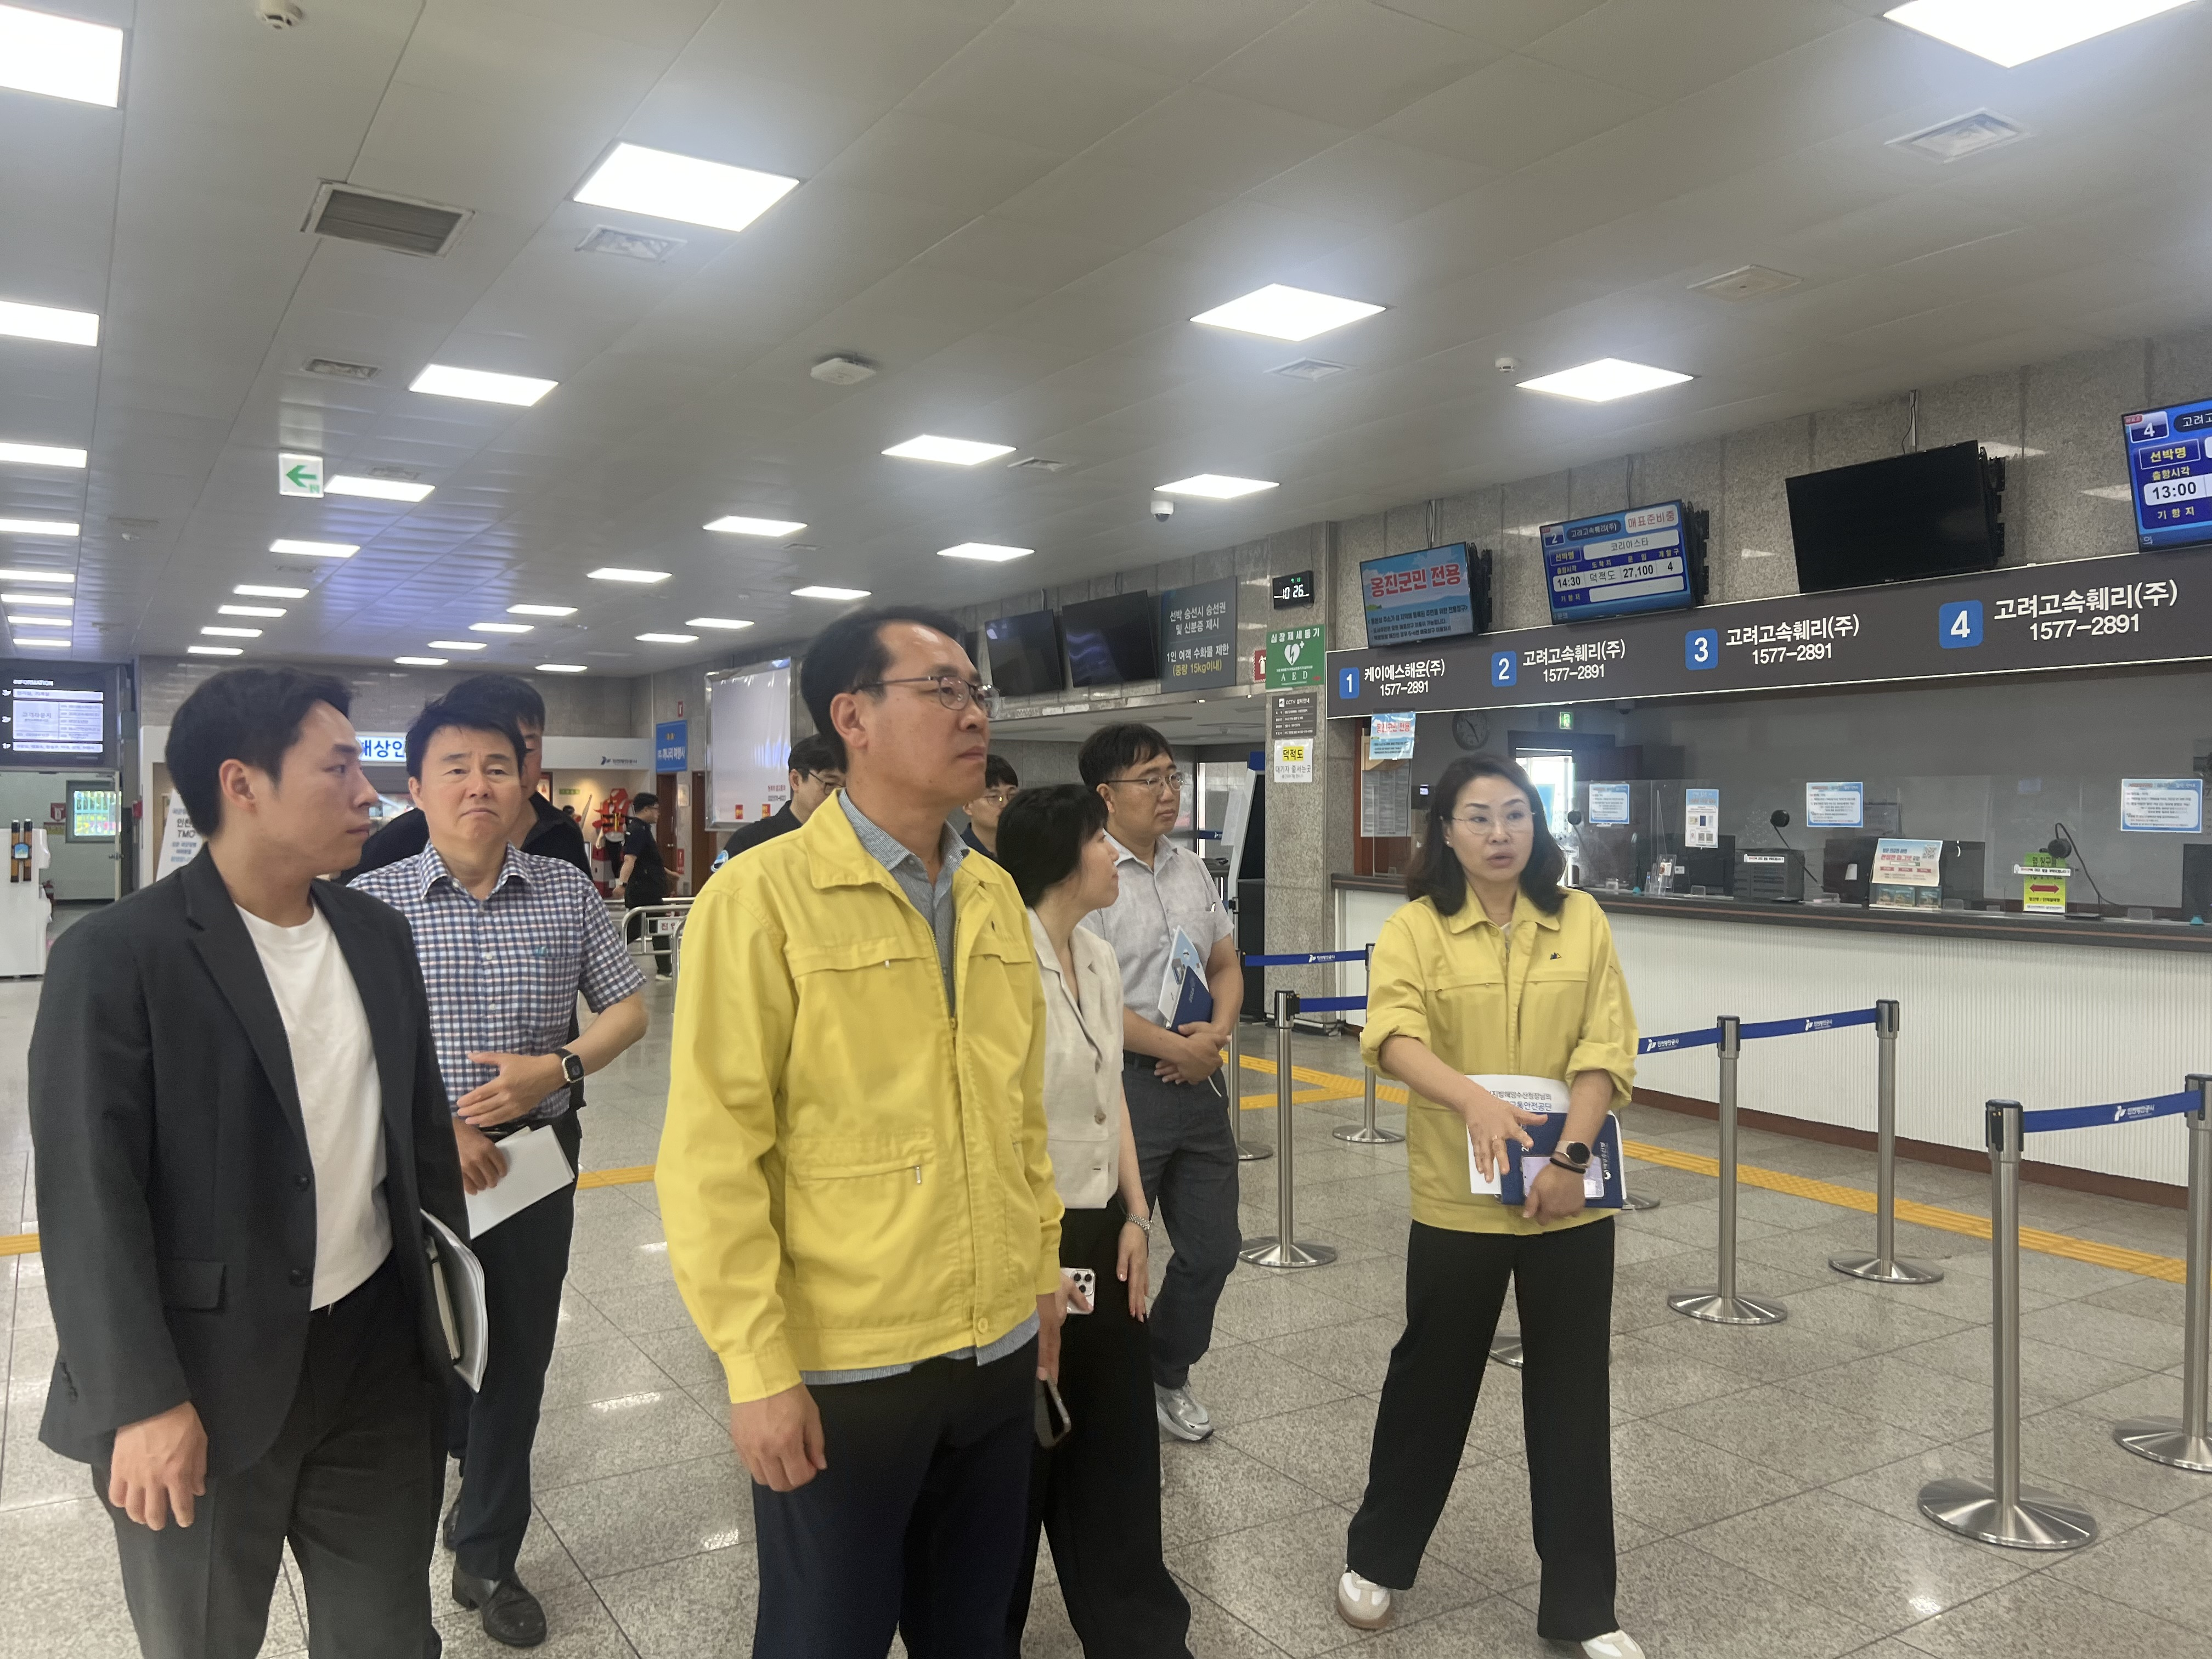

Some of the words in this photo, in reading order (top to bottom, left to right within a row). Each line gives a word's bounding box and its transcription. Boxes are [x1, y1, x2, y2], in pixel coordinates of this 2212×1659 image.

[2143, 422, 2155, 437] 4
[2150, 446, 2187, 463] 선박명
[2152, 466, 2190, 481] 출항시각
[2152, 481, 2197, 500] 13:00
[1628, 510, 1675, 528] 매표준비중
[1551, 533, 1558, 544] 2
[1611, 537, 1649, 552] 코리아스타
[1623, 565, 1654, 578] 27,100
[1667, 561, 1674, 571] 4
[1370, 568, 1427, 598] 옹진군민
[1430, 563, 1461, 588] 전용
[1557, 576, 1581, 589] 14:30
[1589, 569, 1616, 583] 덕적도
[1170, 610, 1182, 623] 선박
[1184, 606, 1204, 620] 승선시
[1206, 601, 1226, 616] 승선권
[1951, 611, 1971, 638] 4
[1995, 579, 2178, 619] 고려고속훼리(주)
[1176, 624, 1182, 636] 및
[1184, 620, 1204, 634] 신분증
[1206, 618, 1219, 631] 제시
[2030, 613, 2138, 641] 1577-2891
[1695, 637, 1708, 662] 3
[1726, 613, 1859, 646] 고려고속훼리(주)
[1167, 652, 1177, 663] 1인
[1179, 649, 1192, 661] 여객
[1193, 646, 1213, 659] 수화물
[1216, 643, 1229, 656] 제한
[1499, 658, 1510, 680] 2
[1523, 639, 1626, 666] 고려고속훼리(주)
[1752, 642, 1831, 664] 1577-2891
[1173, 664, 1188, 677] (중량
[1190, 659, 1222, 674] 15kg이내)
[1346, 673, 1352, 693] 1
[1364, 658, 1445, 681] 케이에스해운(주)
[1543, 664, 1604, 682] 1577-2891
[1380, 680, 1428, 696] 1577-2891
[1283, 749, 1304, 760] 덕적도
[1489, 1090, 1551, 1101] 지방해양수산청장님의
